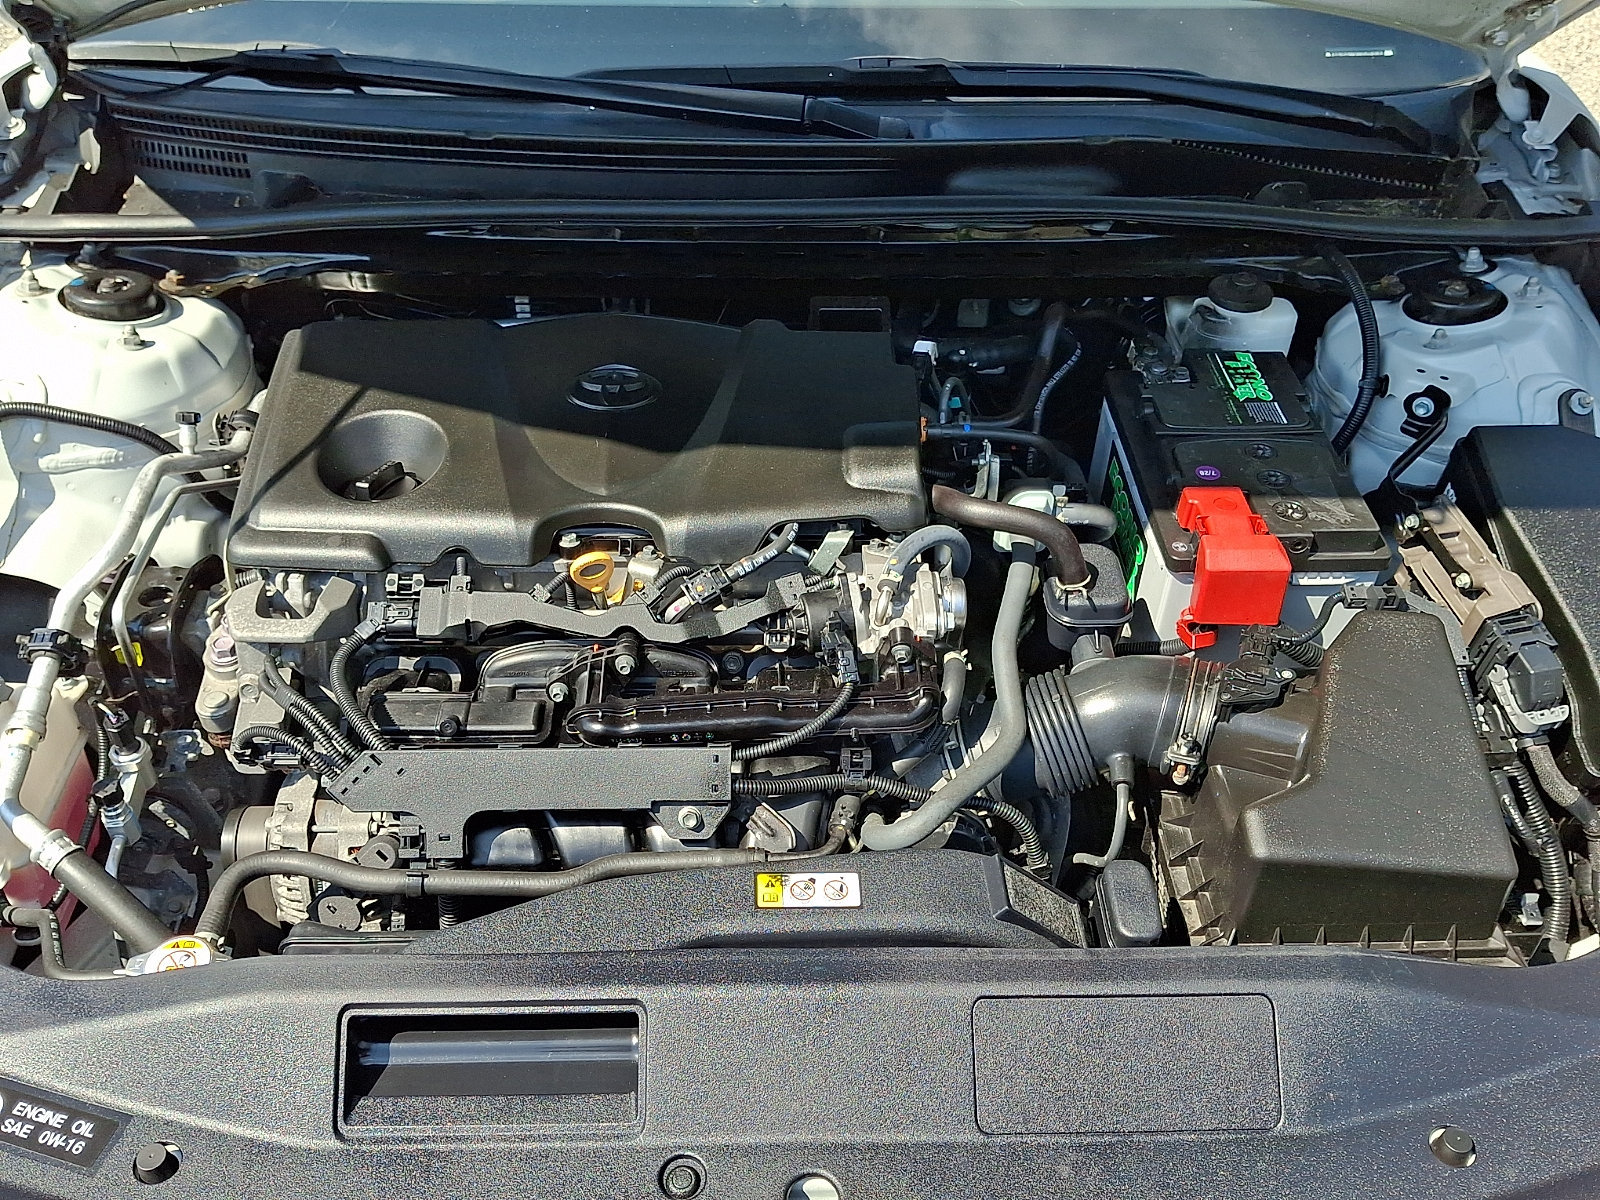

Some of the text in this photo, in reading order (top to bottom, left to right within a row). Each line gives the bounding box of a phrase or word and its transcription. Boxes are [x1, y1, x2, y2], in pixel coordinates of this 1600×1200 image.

[1, 1118, 86, 1155] SAE 0W-16
[12, 1101, 96, 1138] ENGINE OIL
